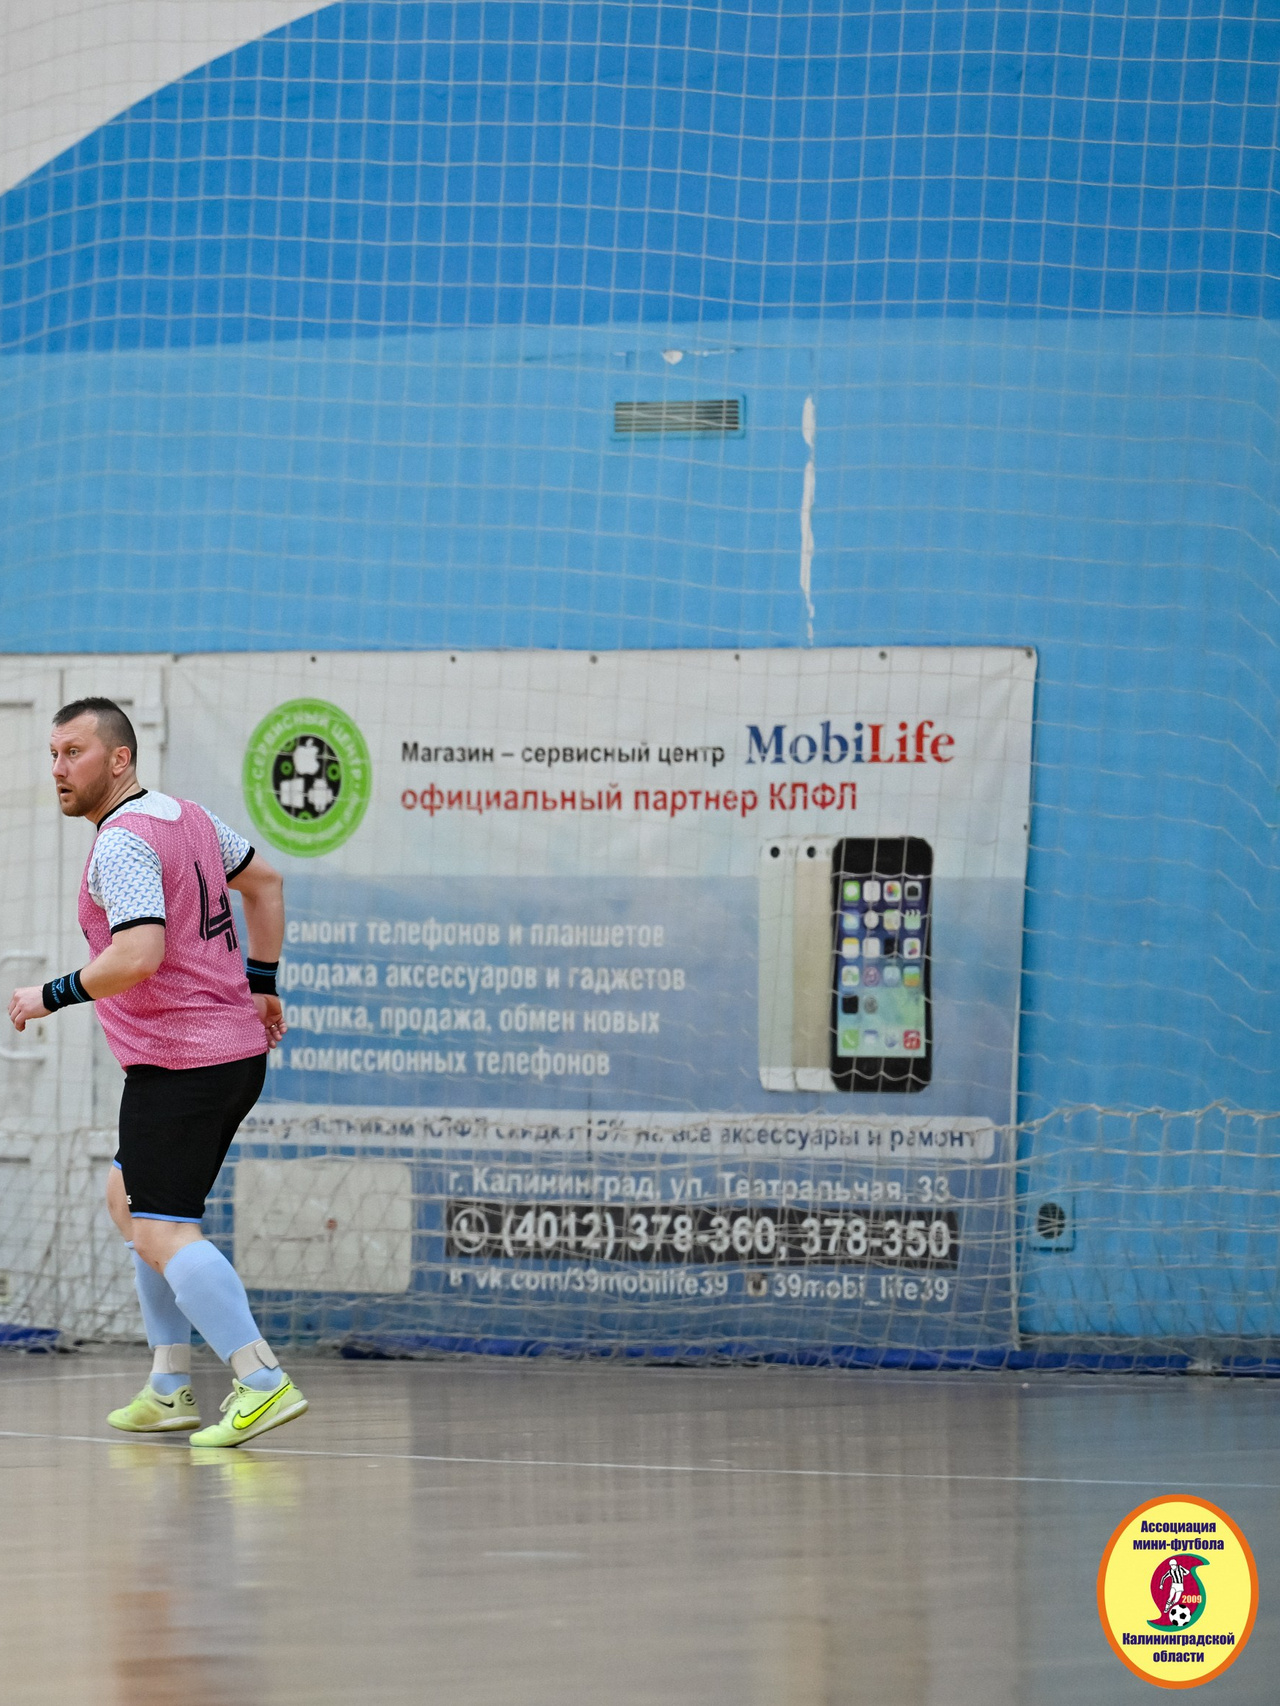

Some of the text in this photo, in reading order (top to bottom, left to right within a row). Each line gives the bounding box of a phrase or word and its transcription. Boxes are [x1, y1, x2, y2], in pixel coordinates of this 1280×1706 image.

[401, 741, 495, 763] Магазин
[520, 740, 651, 768] сервисный
[657, 745, 726, 769] центр
[744, 719, 956, 765] MobiLife
[400, 781, 622, 816] официальный
[632, 791, 759, 816] партнер
[768, 781, 858, 812] КЛФЛ
[194, 859, 238, 953] 4
[286, 916, 665, 951] емонт телефонов и планшетов
[386, 962, 538, 995] аксессуаров
[545, 966, 560, 990] и
[569, 965, 686, 995] гаджетов
[281, 999, 661, 1036] окупка, продажа, обмен новых
[290, 1048, 467, 1074] комиссионных
[475, 1045, 611, 1081] телефонов
[280, 1116, 416, 1140] уастникам
[720, 1125, 860, 1150] аксессуары
[447, 1170, 465, 1192] г.
[670, 1175, 710, 1204] ул.
[918, 1174, 950, 1204] 33
[500, 1209, 952, 1261] (4012) 378-360, 378-350
